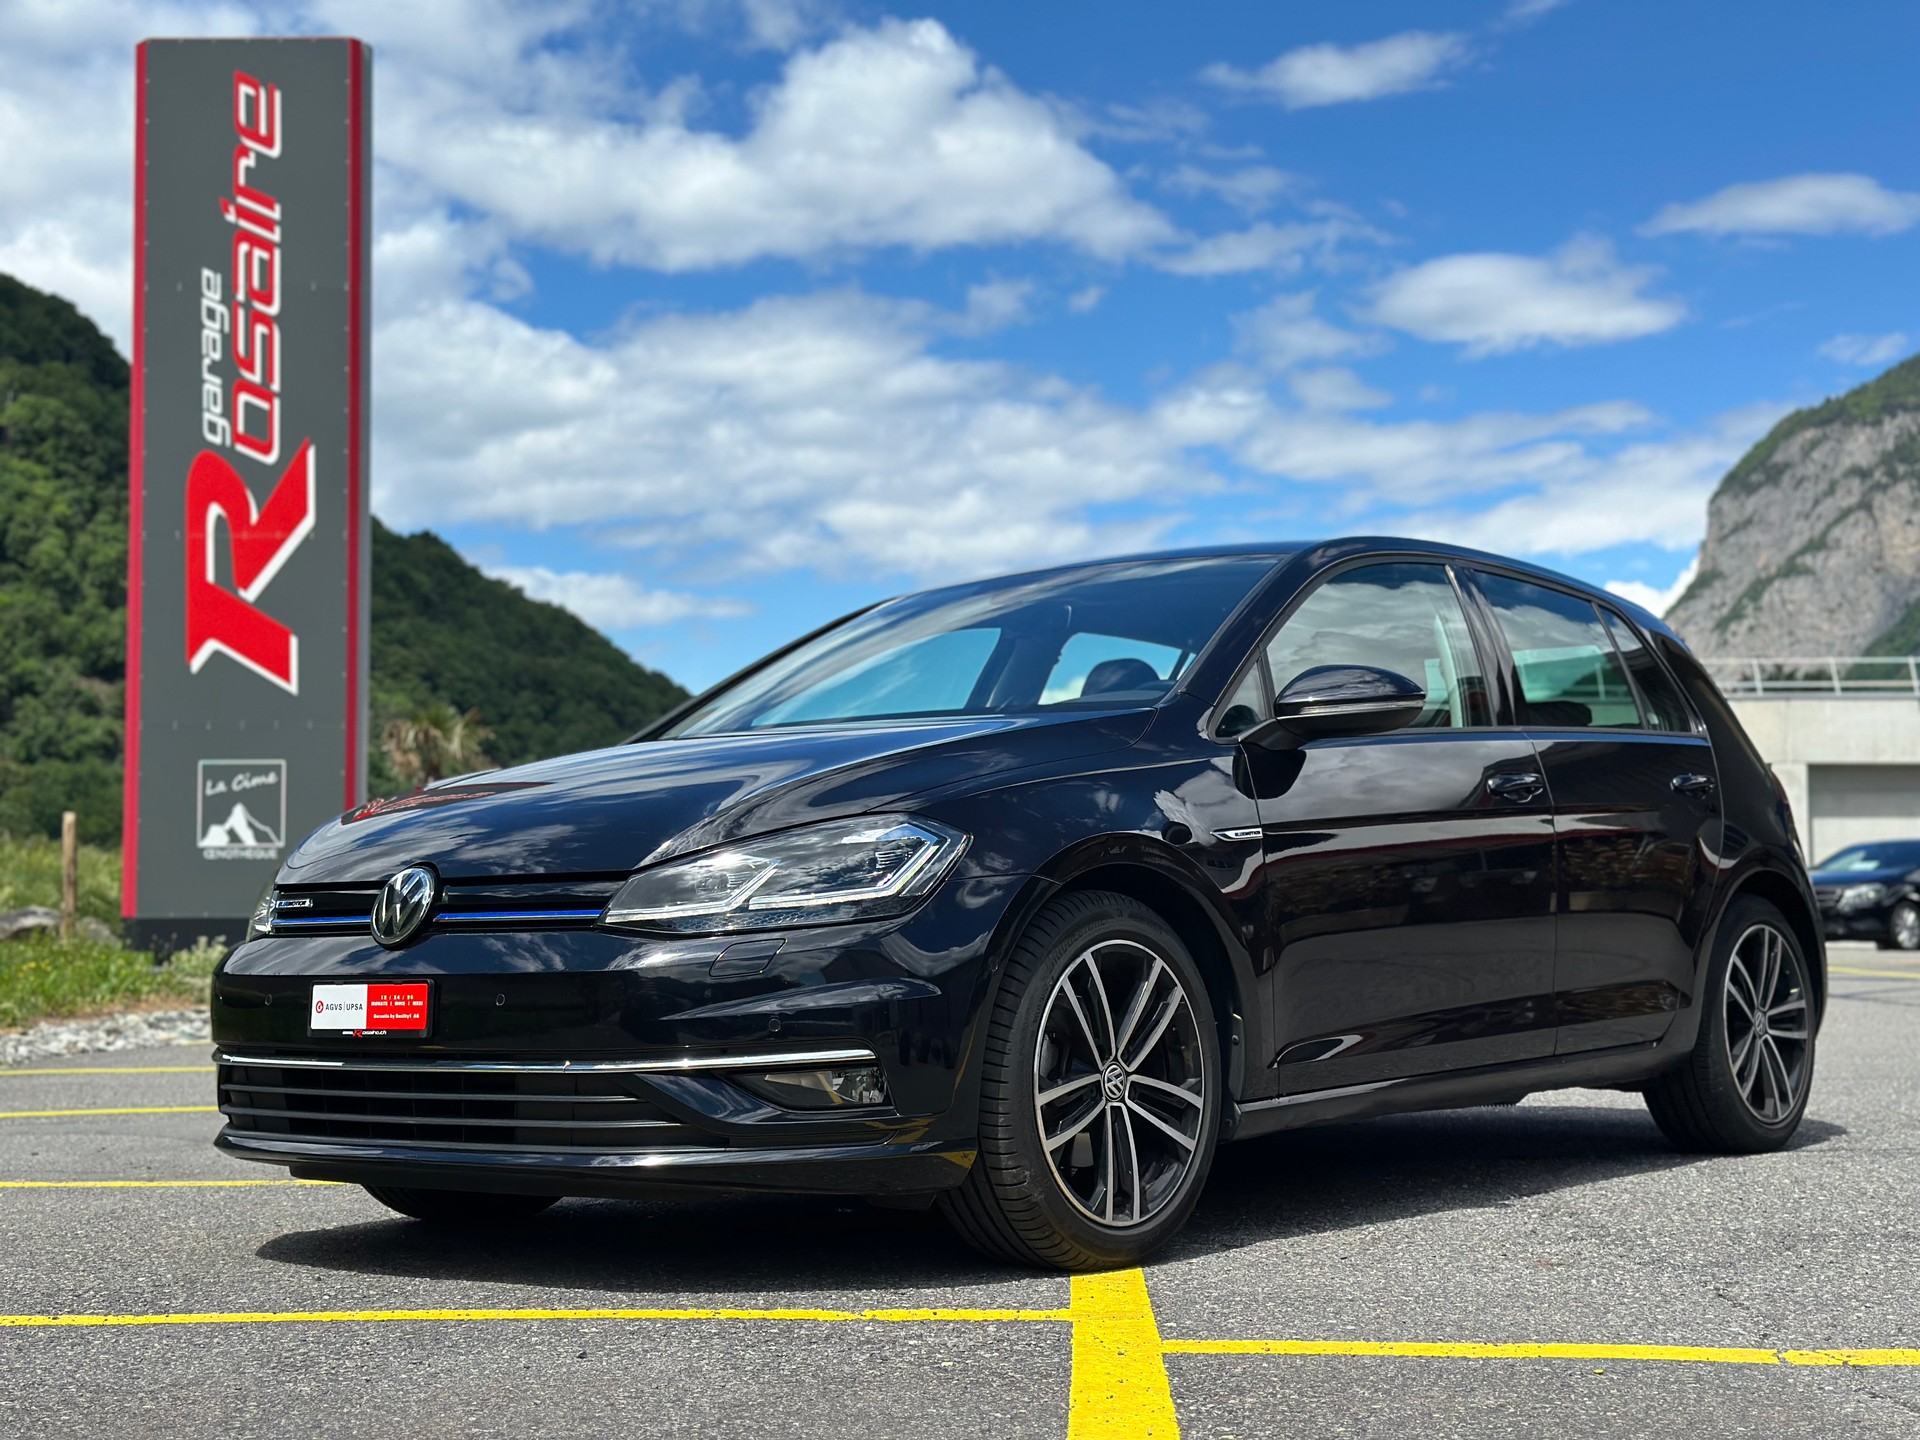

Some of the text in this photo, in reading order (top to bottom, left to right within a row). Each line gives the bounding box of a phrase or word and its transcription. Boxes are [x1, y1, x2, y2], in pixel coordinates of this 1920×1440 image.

[201, 267, 231, 448] garage
[205, 771, 279, 797] La Cime
[346, 1003, 364, 1011] UPSA
